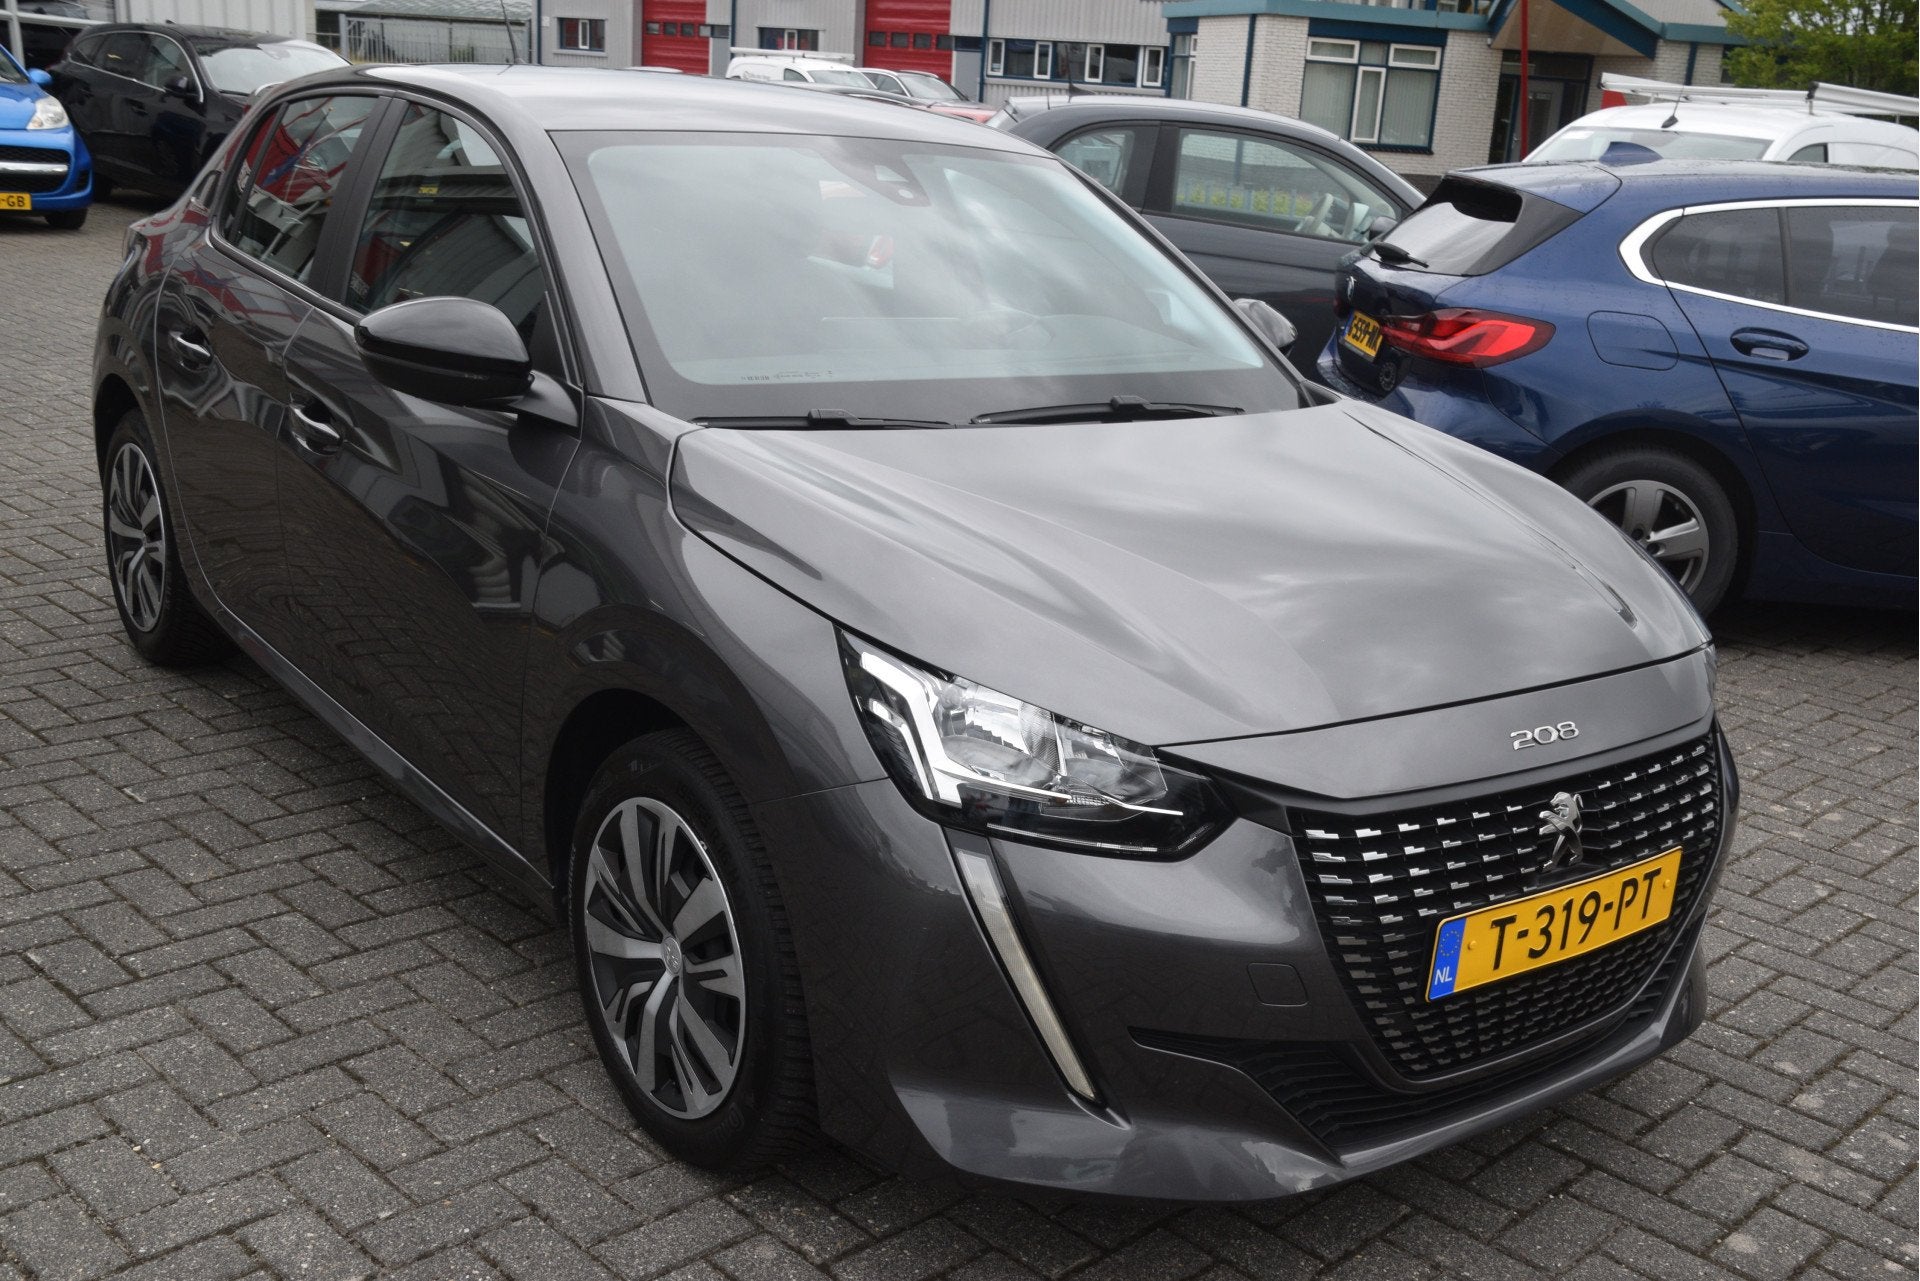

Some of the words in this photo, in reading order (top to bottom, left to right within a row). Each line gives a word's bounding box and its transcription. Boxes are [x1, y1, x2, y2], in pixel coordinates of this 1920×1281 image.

[1510, 721, 1579, 750] 208
[1489, 867, 1662, 971] T-319-PT
[1434, 966, 1453, 985] NL
